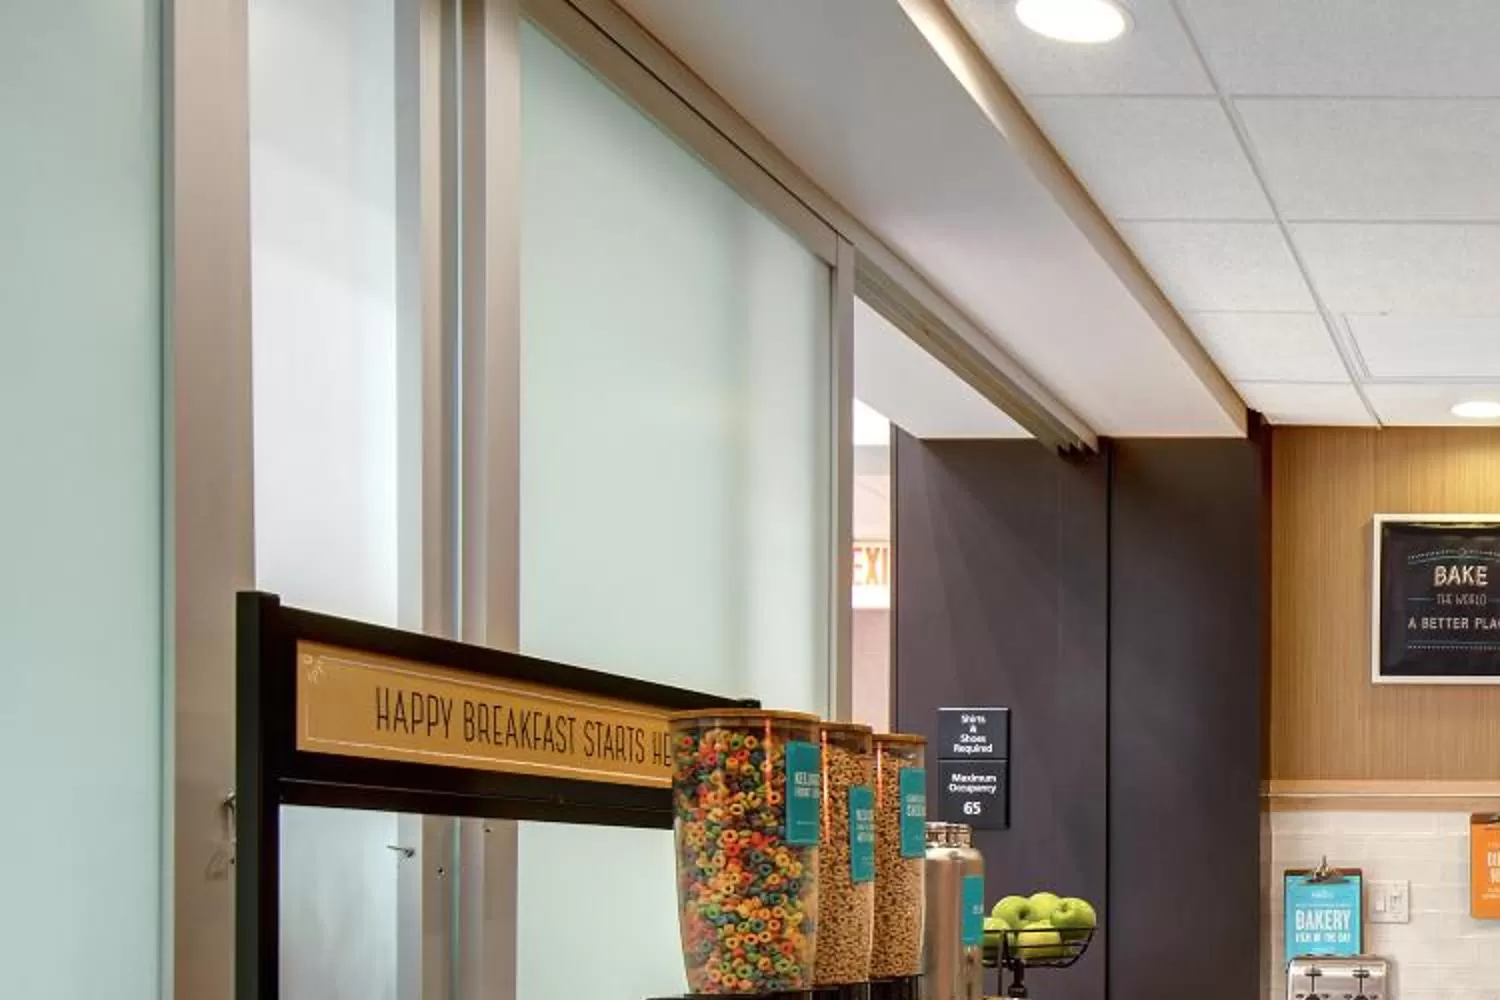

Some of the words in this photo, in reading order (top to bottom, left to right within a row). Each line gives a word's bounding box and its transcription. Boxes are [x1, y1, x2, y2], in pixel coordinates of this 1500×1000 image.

[852, 547, 888, 585] EXI
[1433, 565, 1489, 587] BAKE
[1436, 593, 1453, 606] THE
[1455, 593, 1487, 607] WORLD
[1407, 617, 1417, 629] A
[1421, 617, 1469, 630] BETTER
[961, 714, 986, 724] Shirts
[375, 686, 453, 739] HAPPY
[463, 700, 577, 754] BREAKFAST
[583, 719, 646, 765] STARTS
[652, 731, 672, 767] HE
[960, 733, 986, 743] Shoes
[953, 743, 993, 755] Required
[951, 773, 997, 783] Maximum
[948, 783, 997, 795] Occupancy
[963, 801, 981, 815] 65
[1295, 909, 1351, 931] BAKERY
